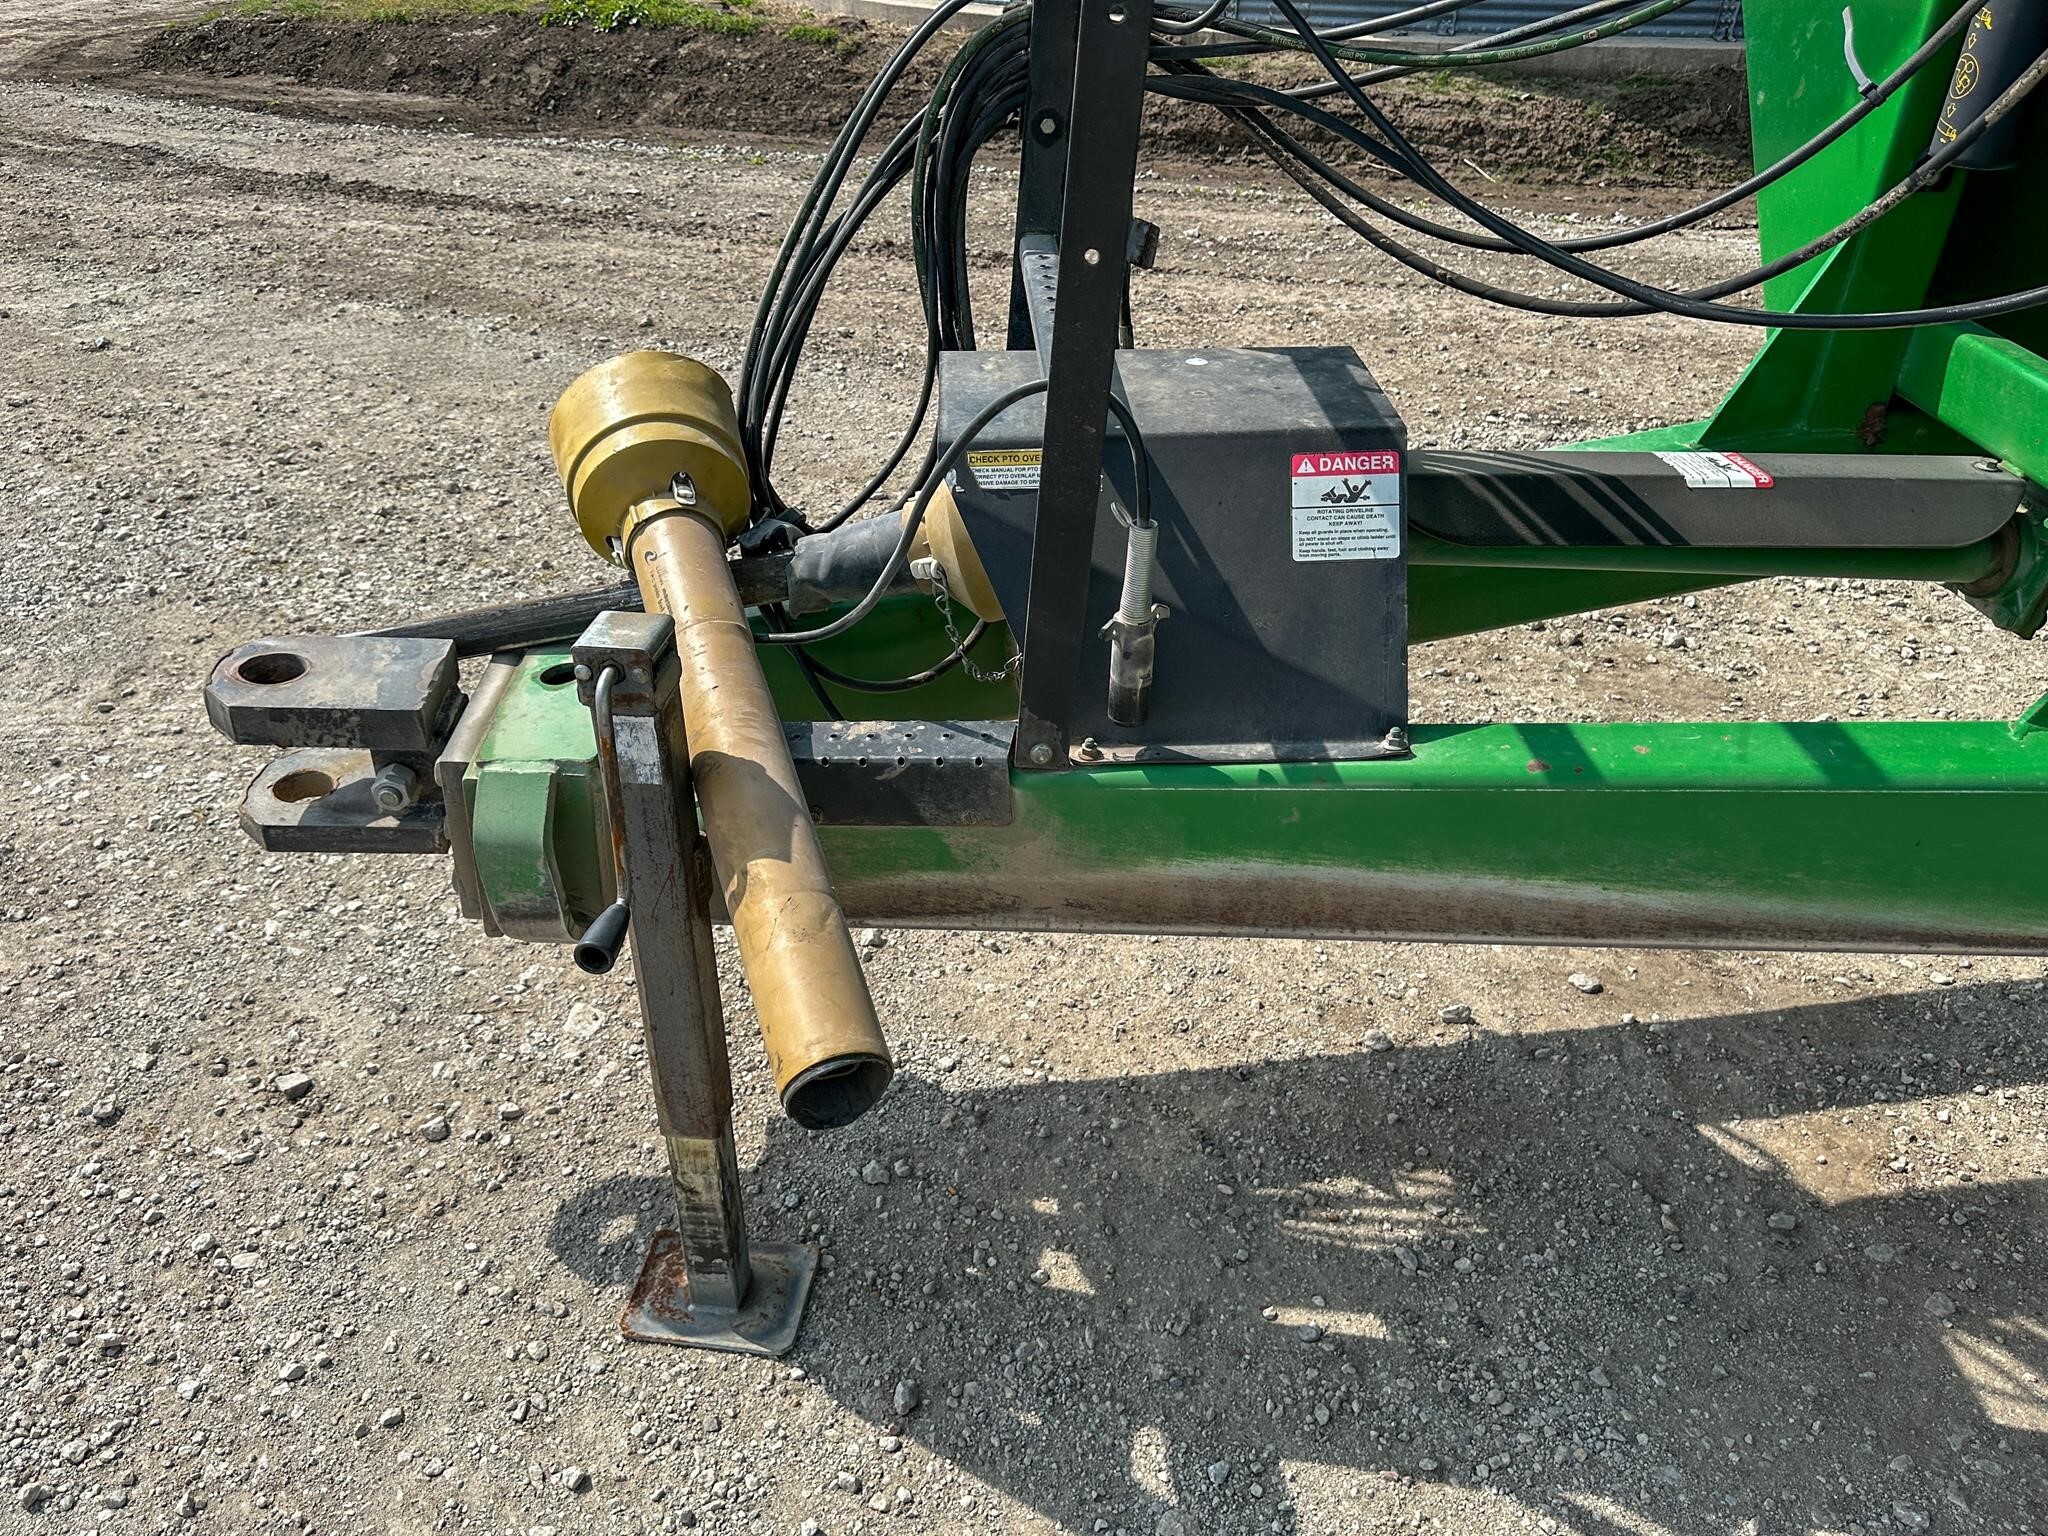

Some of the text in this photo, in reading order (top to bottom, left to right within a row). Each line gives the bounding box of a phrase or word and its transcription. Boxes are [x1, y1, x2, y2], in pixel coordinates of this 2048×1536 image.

[969, 454, 1041, 464] CHECK PTO OVE
[1319, 455, 1394, 472] DANGER
